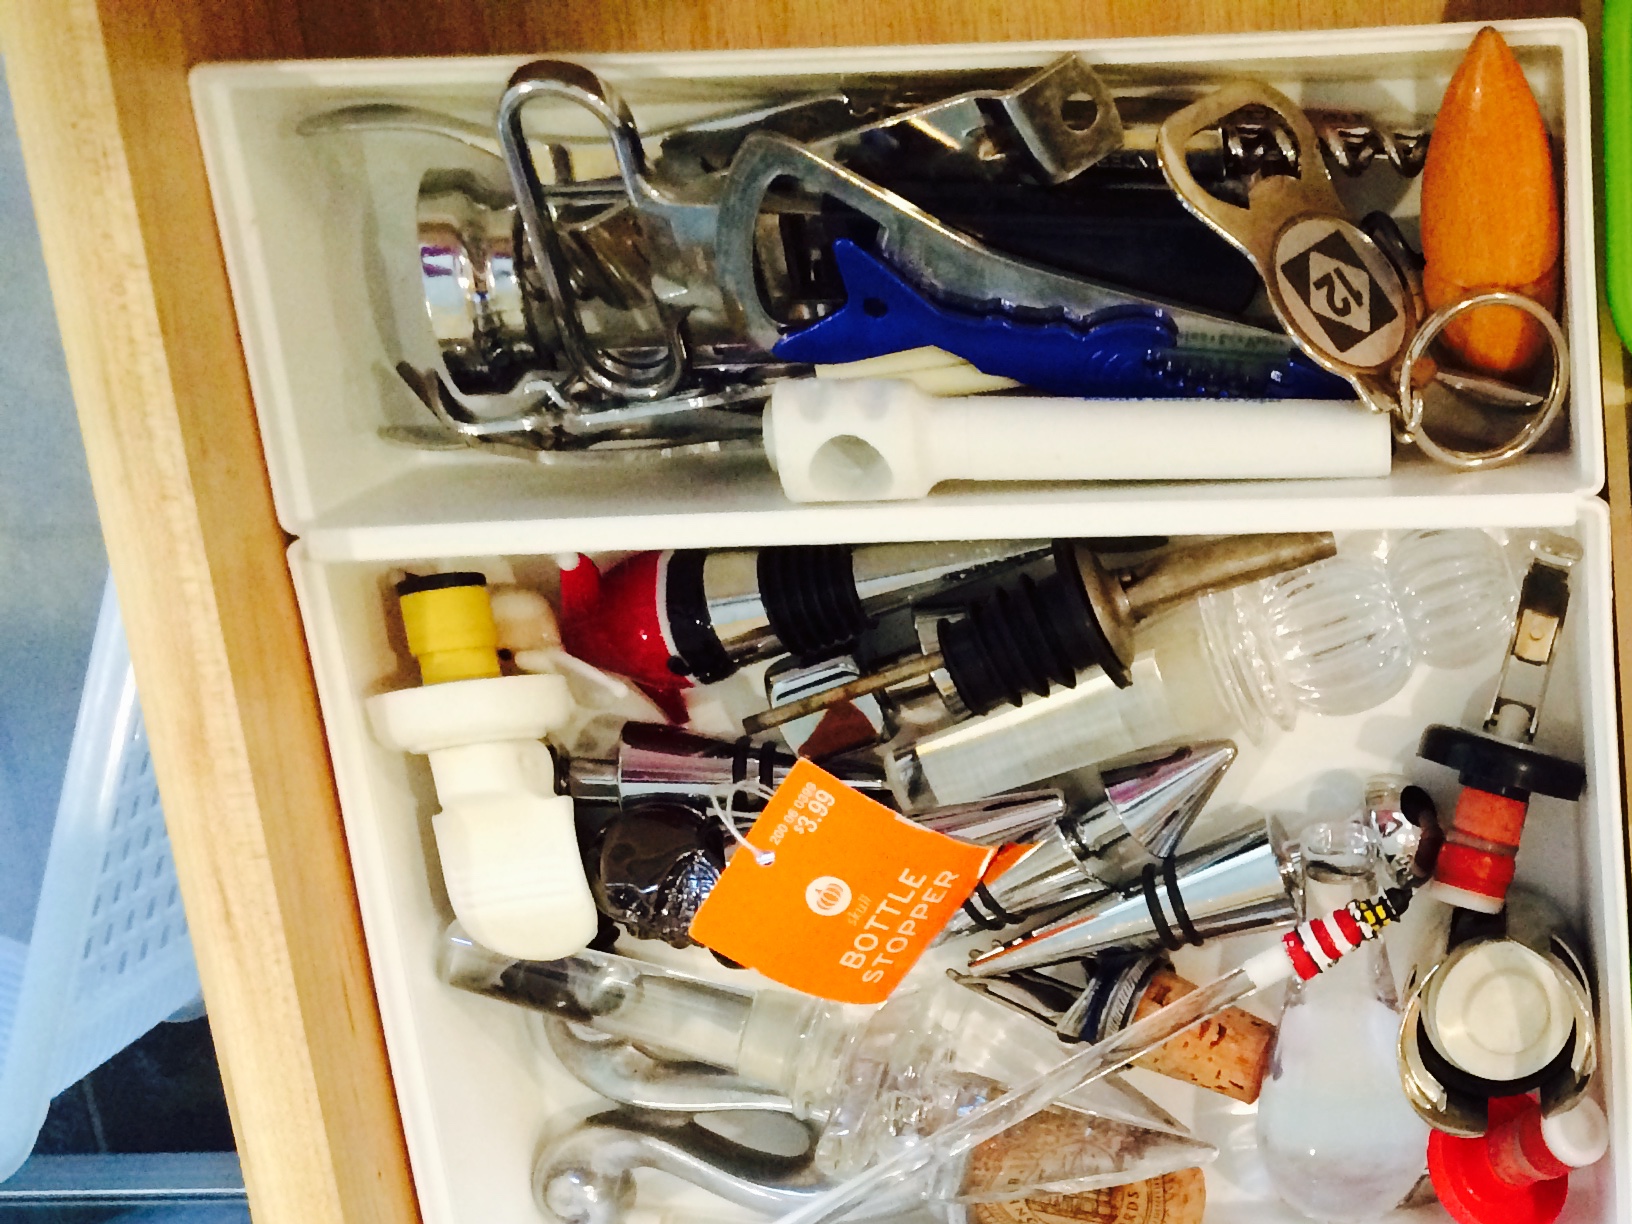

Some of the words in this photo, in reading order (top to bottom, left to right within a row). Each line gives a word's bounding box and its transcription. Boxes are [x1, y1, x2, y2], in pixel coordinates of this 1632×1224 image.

[769, 824, 788, 845] 200
[794, 789, 836, 835] $3.99
[839, 868, 927, 969] BOTTLE
[847, 894, 872, 926] skull
[862, 870, 960, 984] STOPPER
